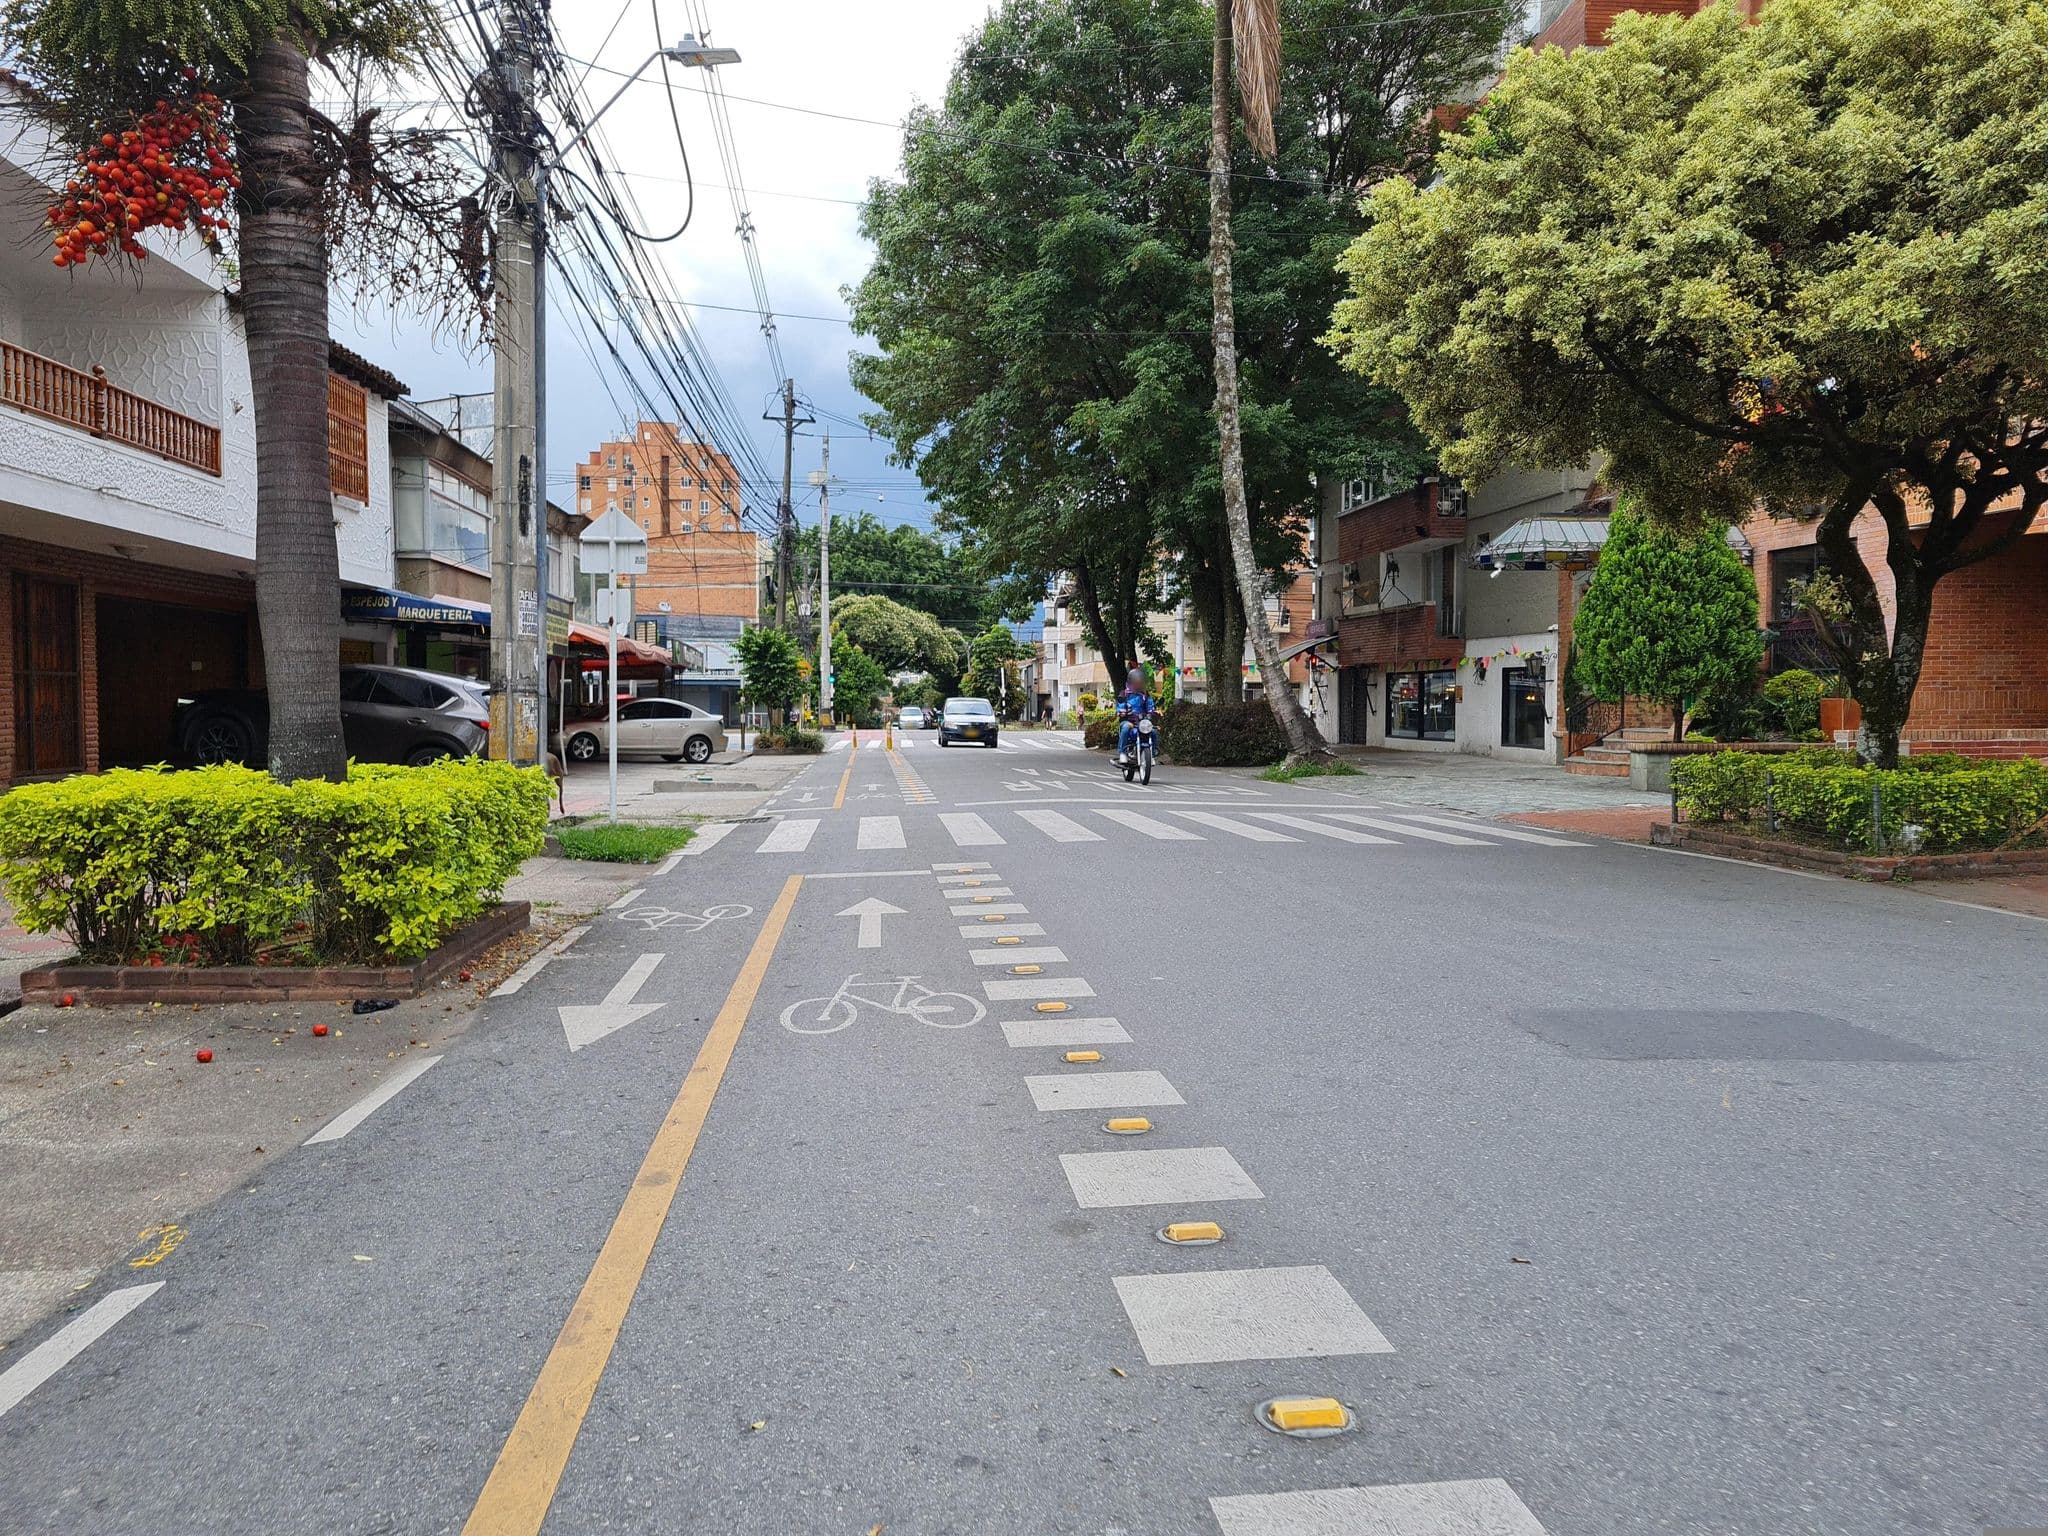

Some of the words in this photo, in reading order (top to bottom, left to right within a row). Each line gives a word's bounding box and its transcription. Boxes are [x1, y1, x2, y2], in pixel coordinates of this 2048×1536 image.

[351, 596, 390, 608] ESPEJOS
[391, 596, 399, 608] Y
[1010, 767, 1160, 781] ONA
[999, 780, 1273, 796] ESCOLAR
